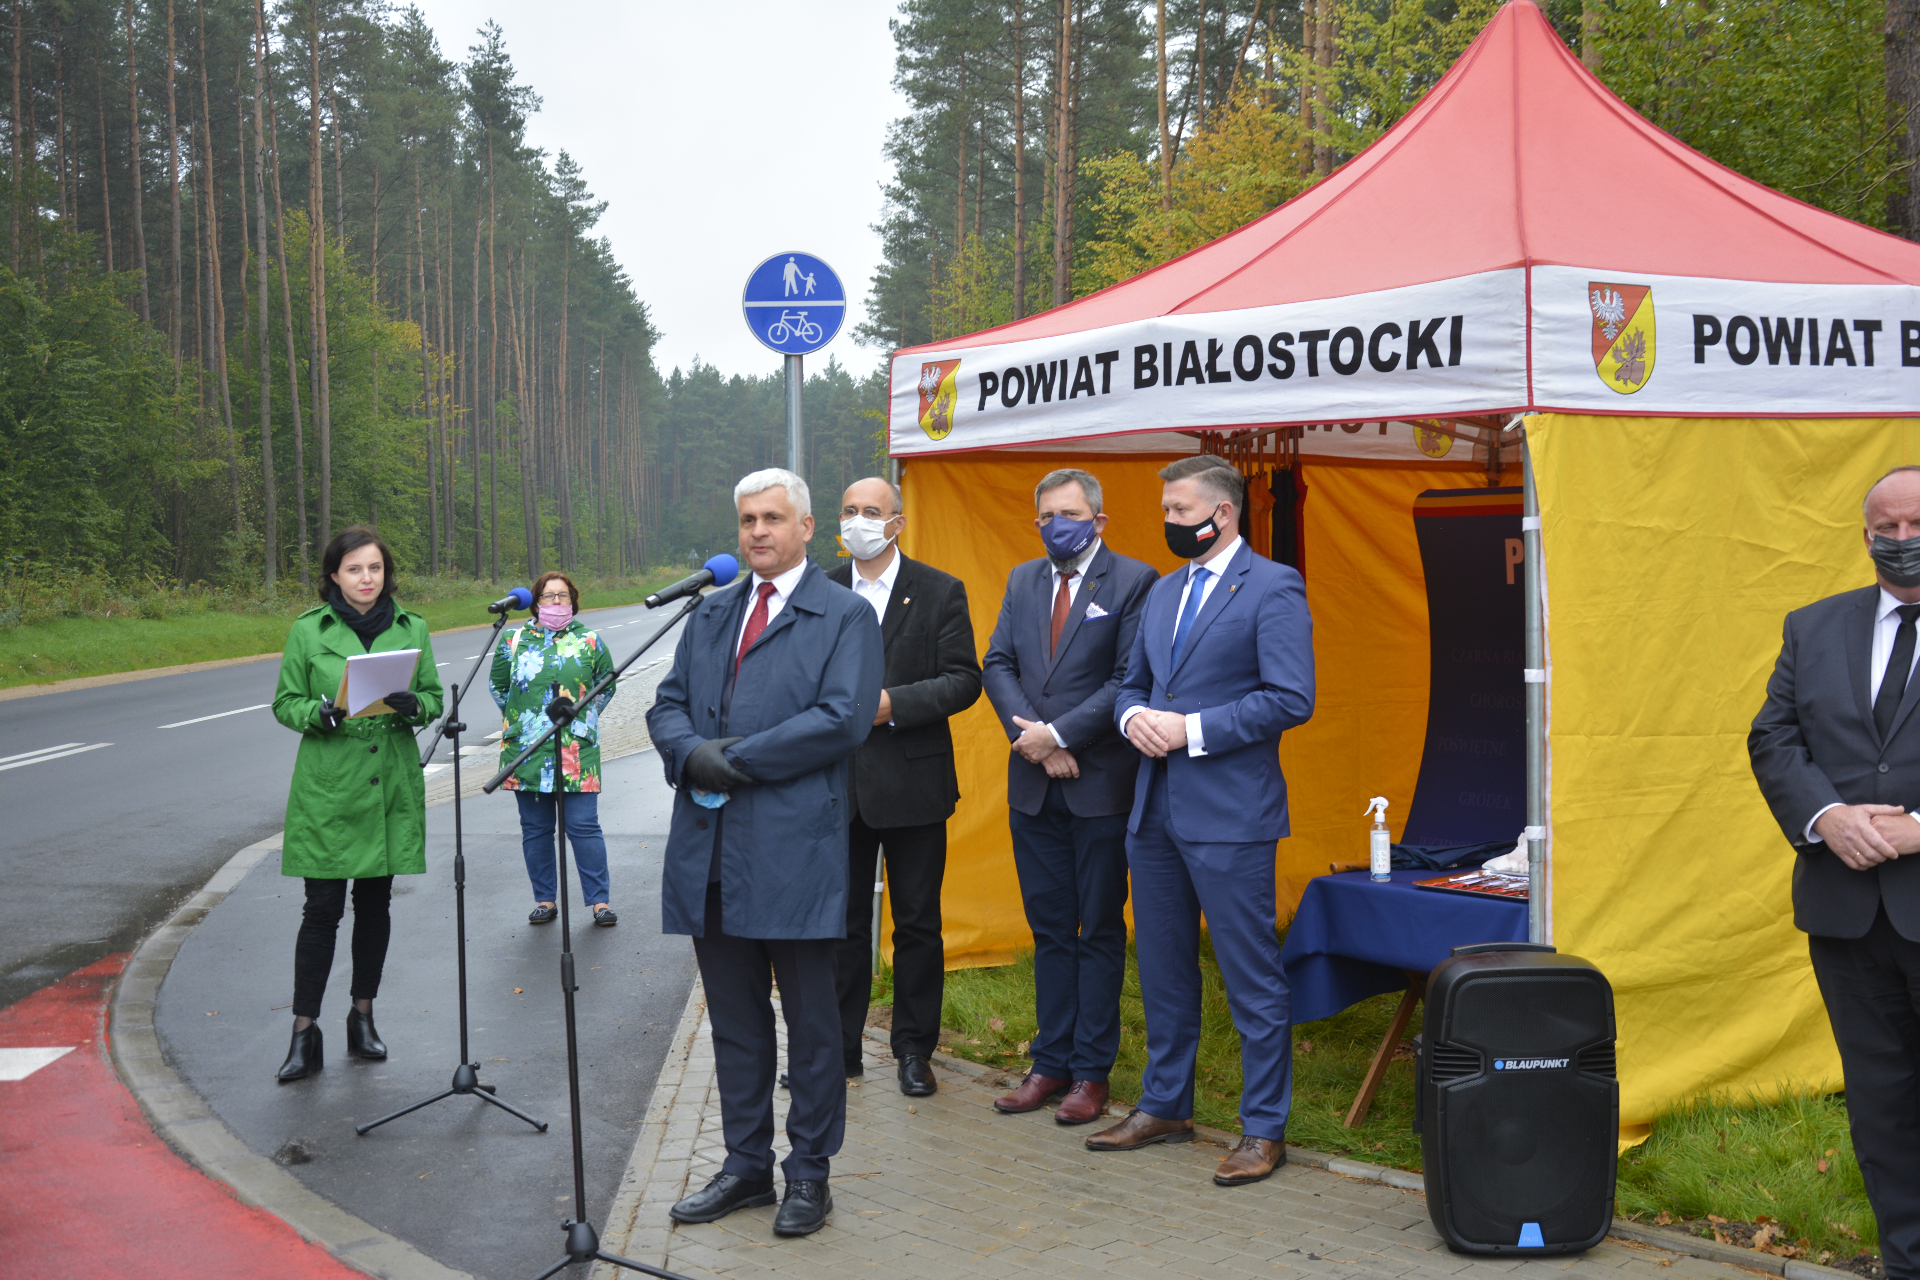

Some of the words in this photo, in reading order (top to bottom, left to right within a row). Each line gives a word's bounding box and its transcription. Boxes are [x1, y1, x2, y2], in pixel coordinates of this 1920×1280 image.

[1692, 314, 1883, 367] POWIAT
[1900, 320, 1920, 367] B
[978, 350, 1119, 411] POWIAT
[1134, 315, 1463, 389] BIAŁOSTOCKI
[1505, 538, 1525, 584] P
[1451, 647, 1500, 664] CZARNA
[1503, 649, 1524, 665] BIA
[1438, 735, 1507, 758] POŚWIĘTNE
[1458, 788, 1513, 810] GRÓDEK
[1504, 1058, 1570, 1070] BLAUPUNKT
